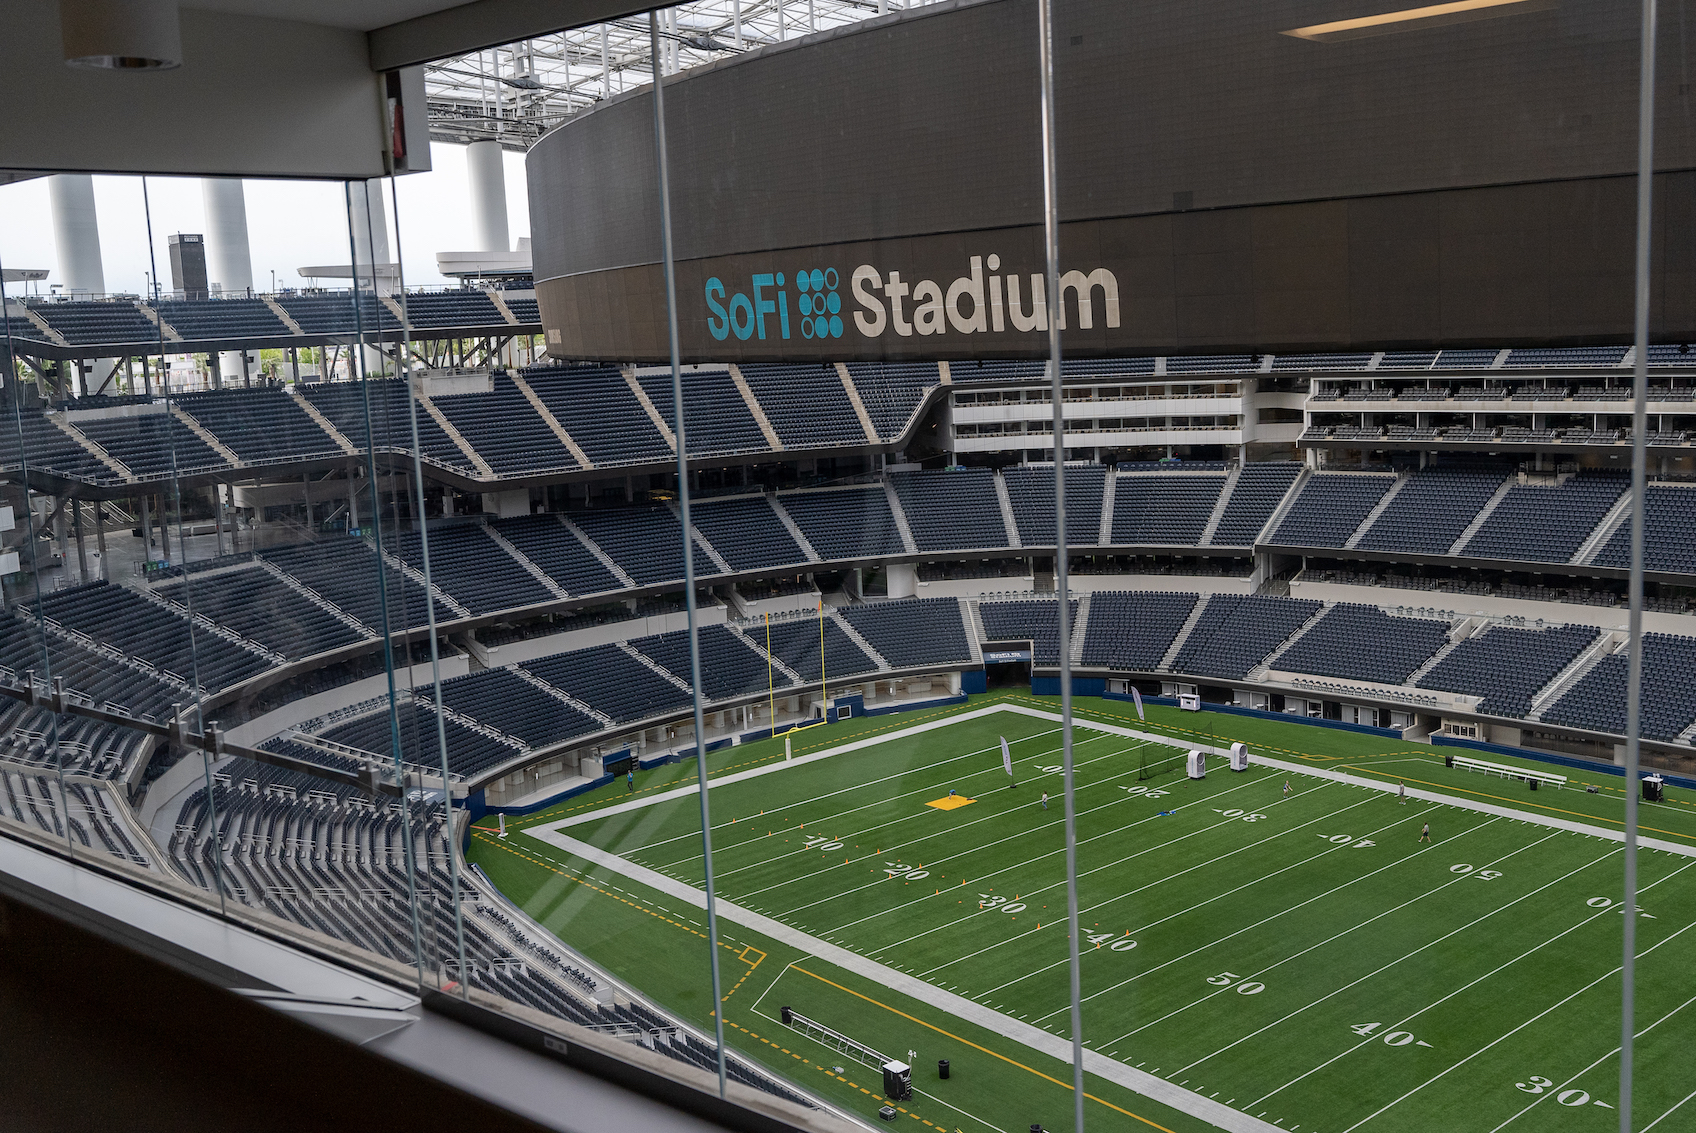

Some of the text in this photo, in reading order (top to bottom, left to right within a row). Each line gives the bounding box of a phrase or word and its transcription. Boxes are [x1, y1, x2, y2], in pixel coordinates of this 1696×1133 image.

[705, 253, 1121, 341] SoFi Stadium
[1127, 786, 1171, 798] 20
[1222, 809, 1267, 822] 30
[802, 837, 844, 851] 10
[1329, 834, 1376, 848] 40
[883, 864, 930, 880] 20
[1449, 863, 1503, 880] 50
[978, 896, 1027, 914] 30
[1086, 933, 1138, 951] 40
[1206, 971, 1266, 995] 50
[1350, 1022, 1414, 1047] 40
[1515, 1075, 1590, 1106] 30
